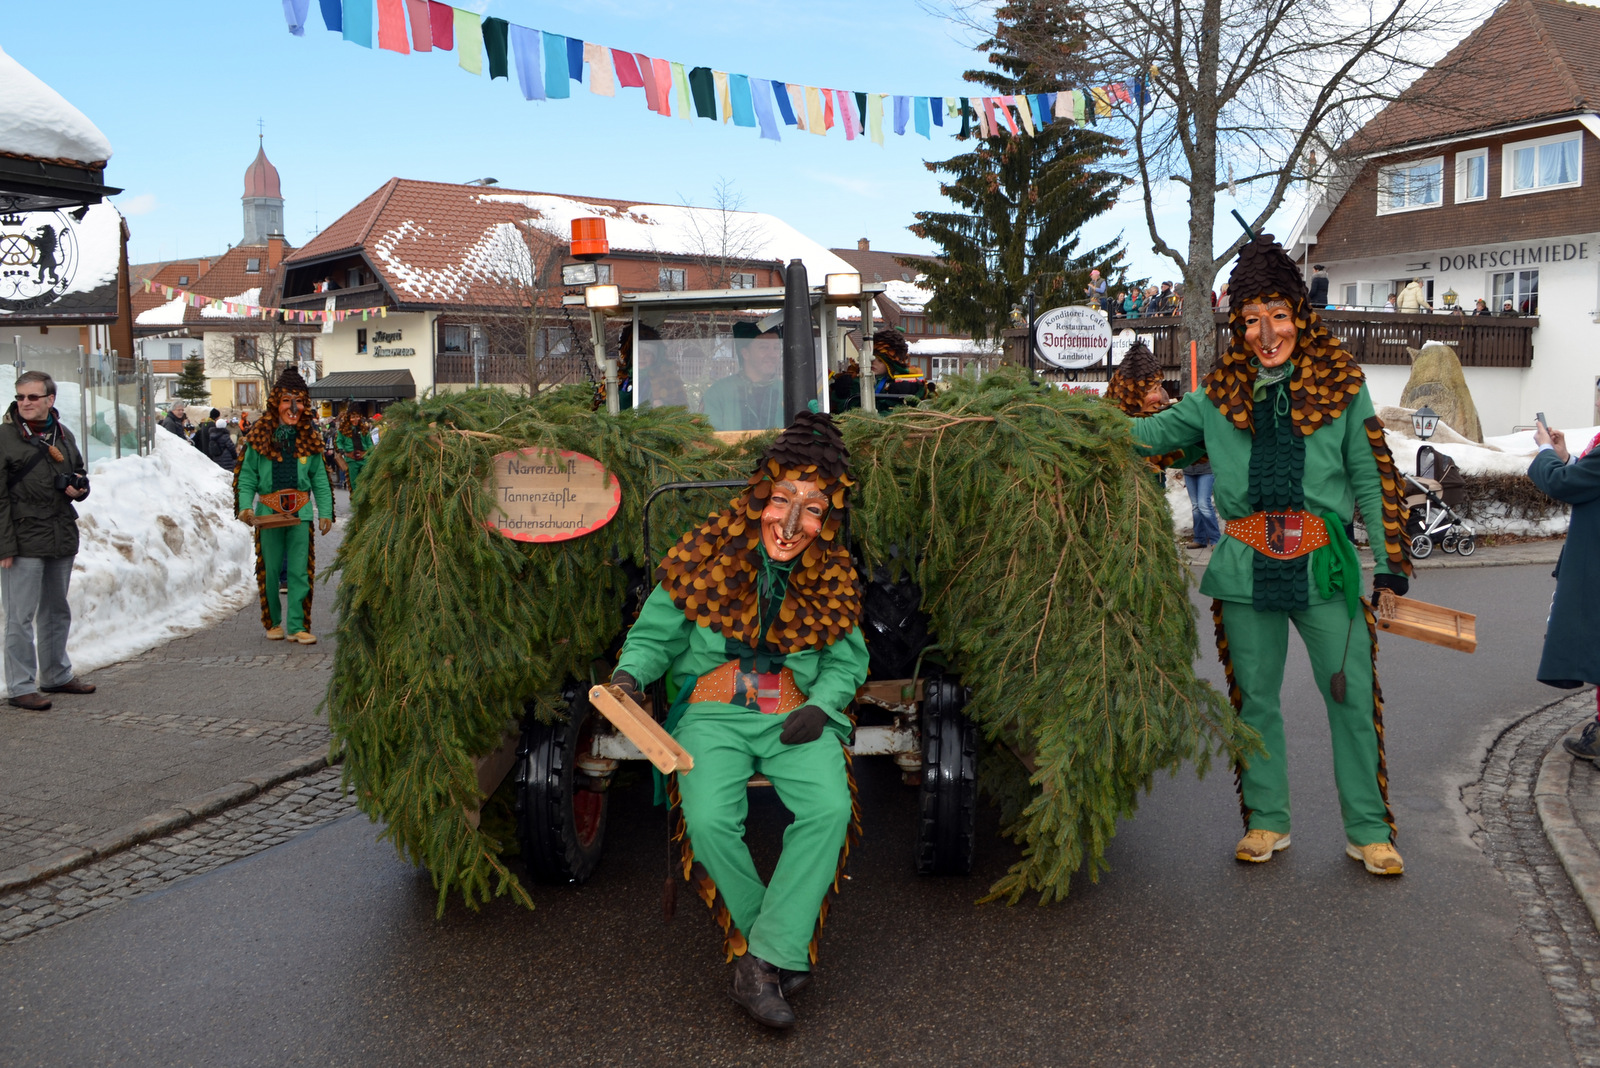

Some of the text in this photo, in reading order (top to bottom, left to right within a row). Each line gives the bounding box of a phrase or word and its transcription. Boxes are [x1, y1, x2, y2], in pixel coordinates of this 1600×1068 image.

[1440, 242, 1588, 272] DORFSCHMIEDE
[1045, 310, 1085, 327] Konditorei
[1090, 313, 1106, 328] Café
[1056, 323, 1096, 331] Restaurant
[1043, 332, 1108, 350] Dorfschmiede
[1057, 353, 1094, 361] Landhotel
[498, 486, 577, 509] Tannenzäpfle
